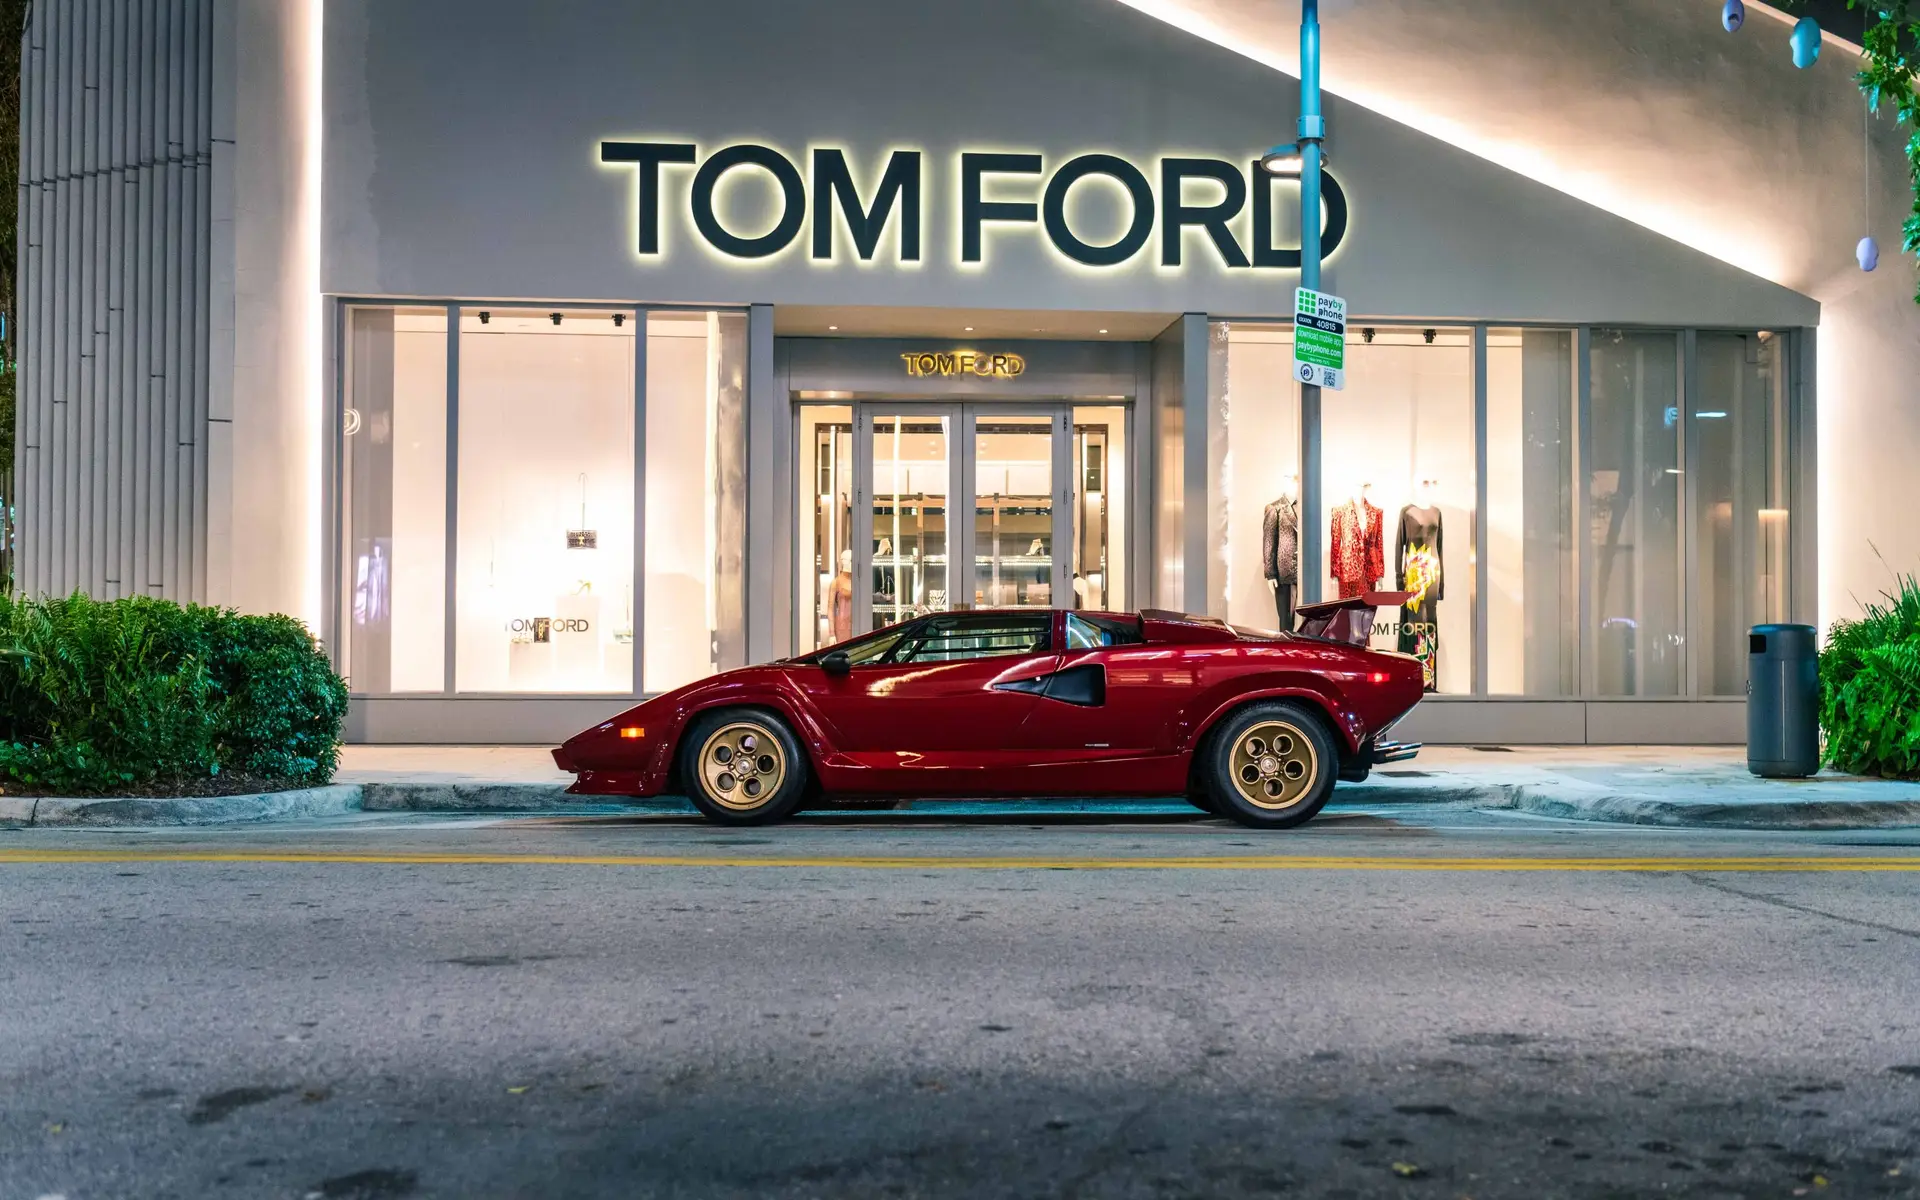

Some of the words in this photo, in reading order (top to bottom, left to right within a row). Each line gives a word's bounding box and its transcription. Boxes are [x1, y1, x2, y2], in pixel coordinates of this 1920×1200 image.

[601, 141, 921, 261] TOM
[961, 153, 1348, 268] FORD
[1318, 297, 1342, 311] payby
[1318, 307, 1343, 320] phone
[1316, 320, 1336, 331] 40815
[1297, 341, 1341, 357] paybyphone.com
[902, 353, 954, 376] TOM
[960, 353, 1025, 376] FORD
[543, 619, 589, 632] FORD
[1393, 622, 1436, 635] FORD
